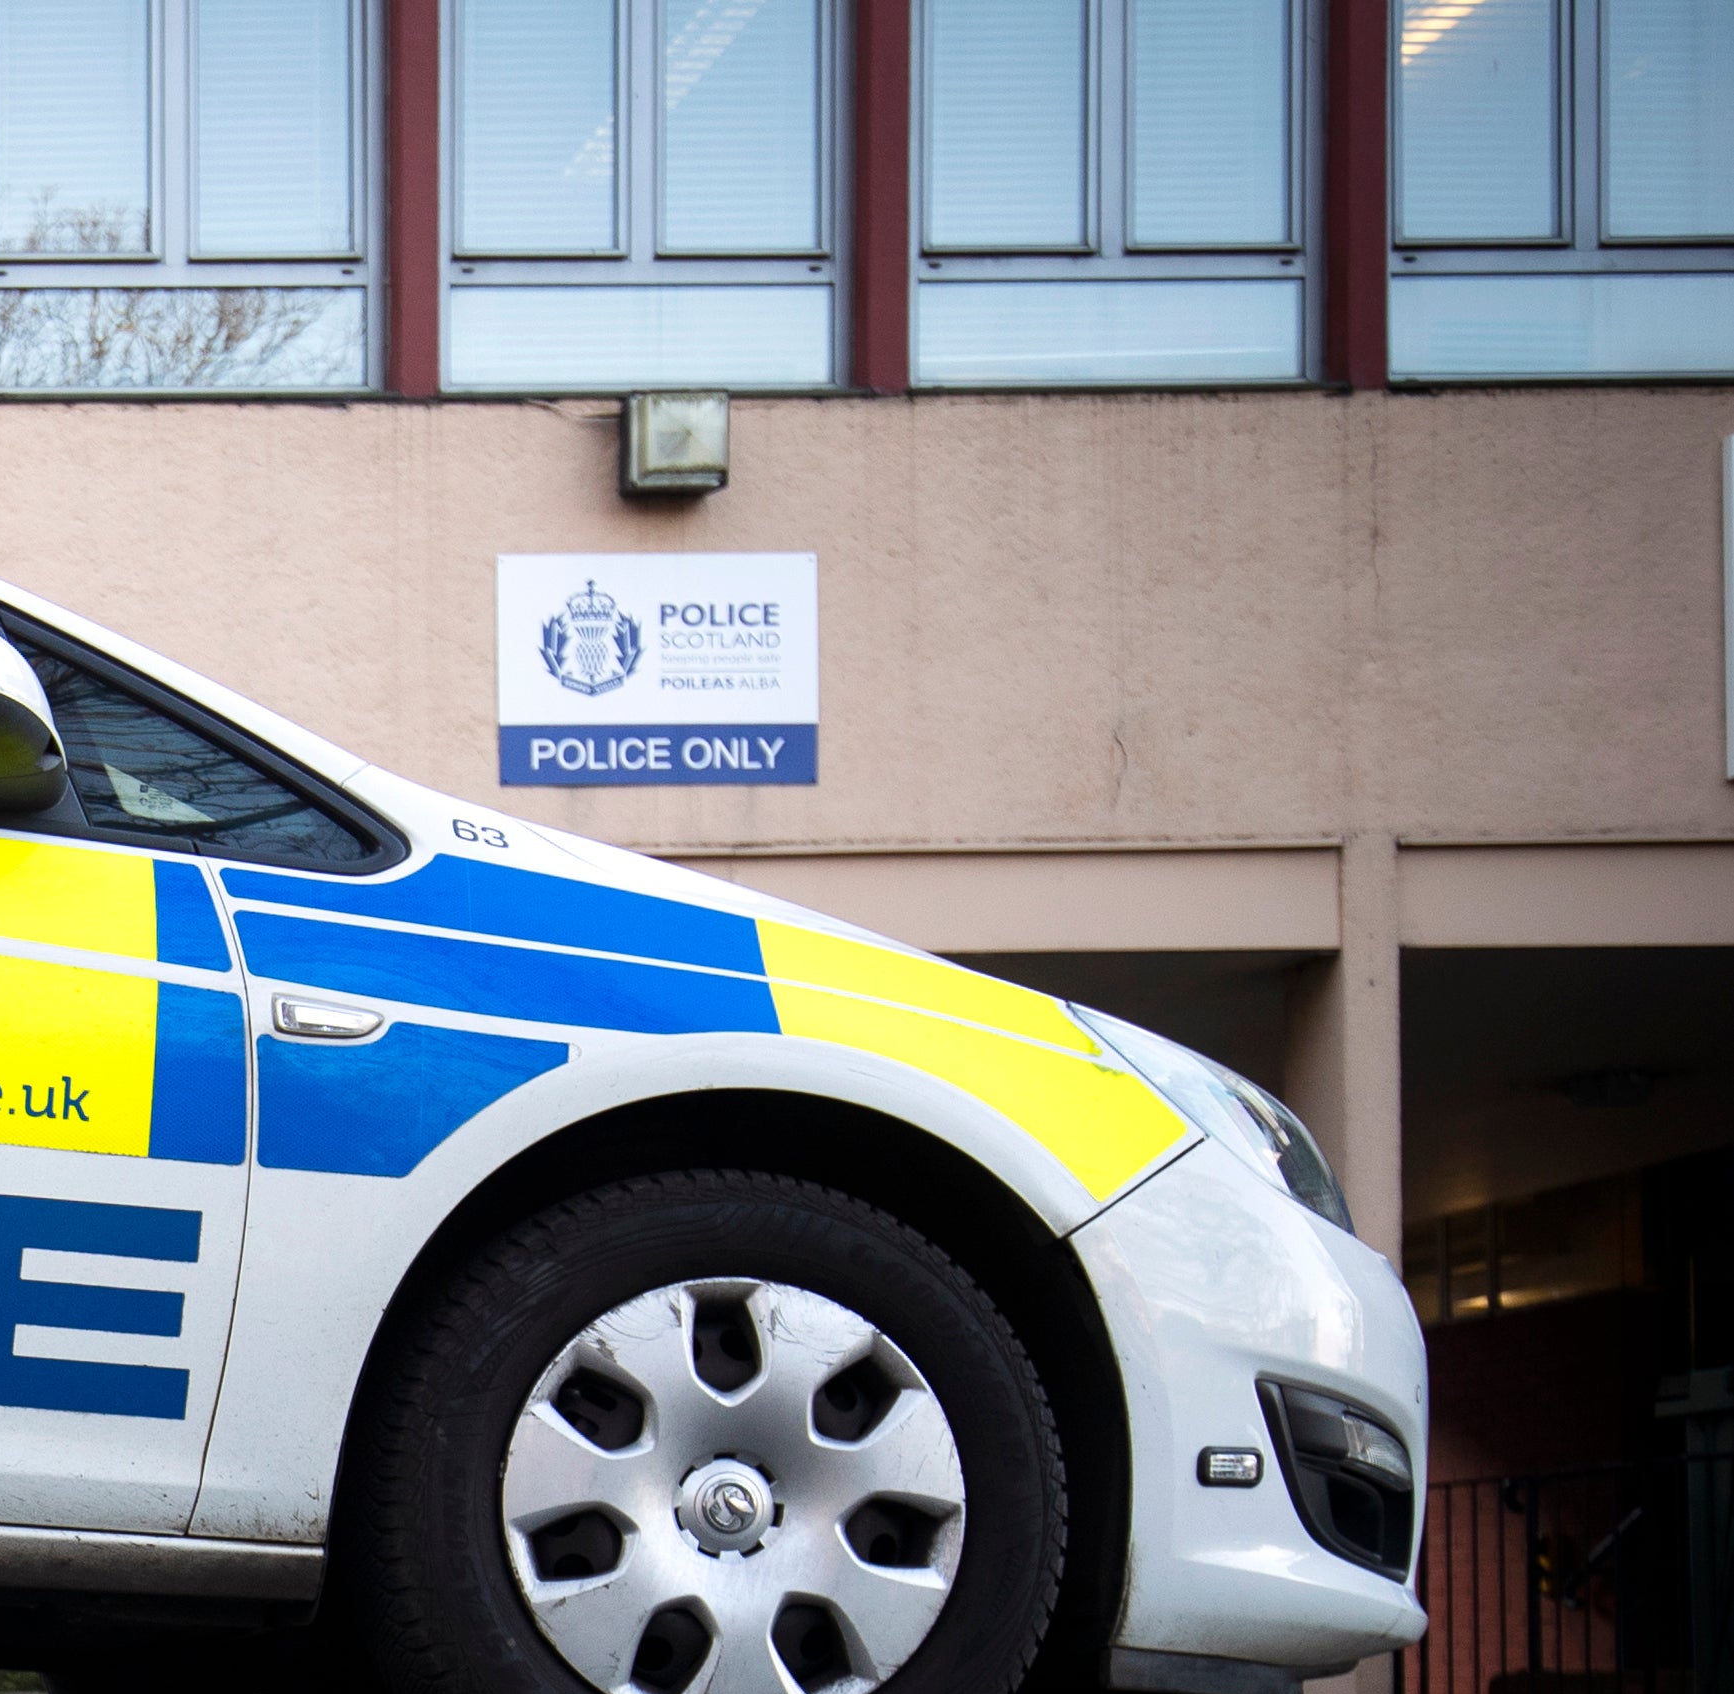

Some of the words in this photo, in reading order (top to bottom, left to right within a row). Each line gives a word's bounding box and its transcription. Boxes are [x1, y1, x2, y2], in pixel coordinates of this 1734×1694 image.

[660, 603, 780, 627] POLICE
[661, 631, 781, 650] SCOTLAND
[661, 677, 734, 690] POILEAS
[739, 677, 782, 690] ALBA
[531, 738, 673, 771] POLICE
[683, 737, 786, 770] ONLY
[452, 818, 509, 848] 63
